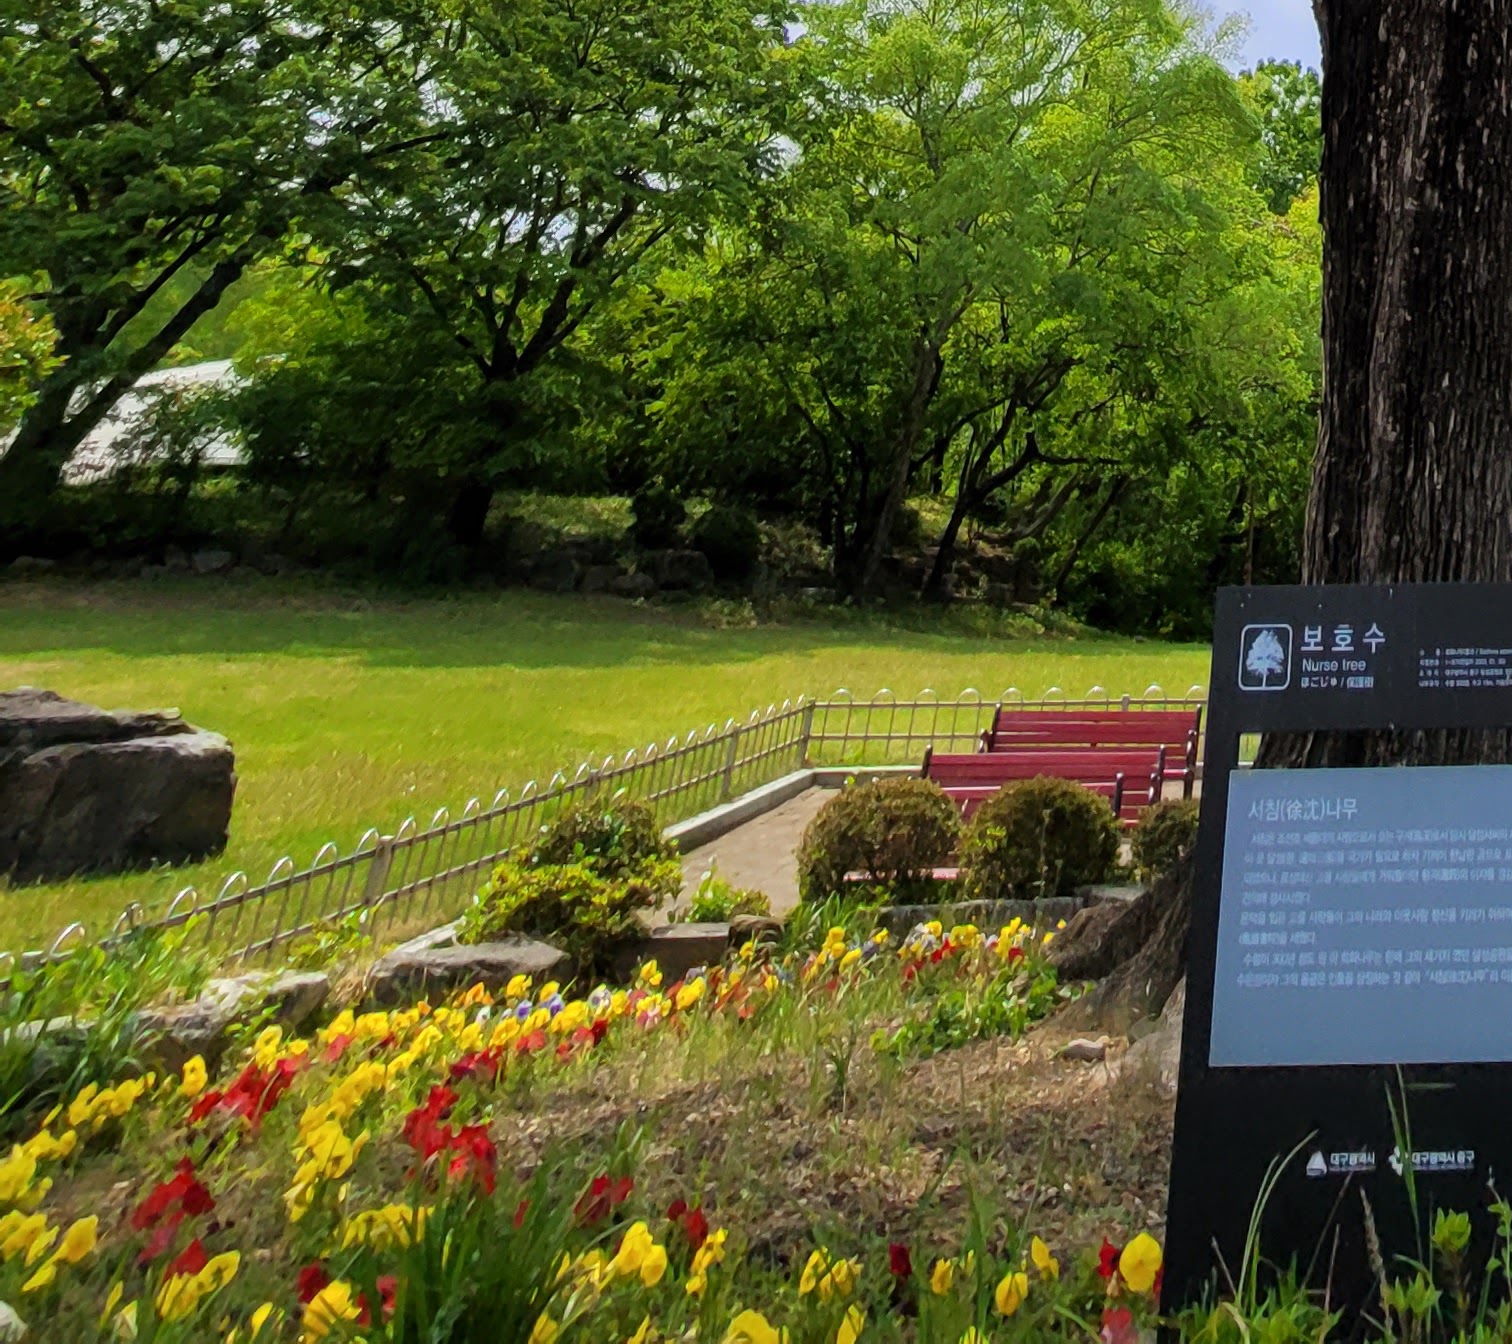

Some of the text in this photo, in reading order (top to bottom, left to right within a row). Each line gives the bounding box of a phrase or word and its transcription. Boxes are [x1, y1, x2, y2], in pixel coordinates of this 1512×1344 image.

[1301, 622, 1385, 653] 보호수
[1302, 658, 1366, 672] Nurse tree
[1248, 797, 1358, 822] 서침(徐沈)나무
